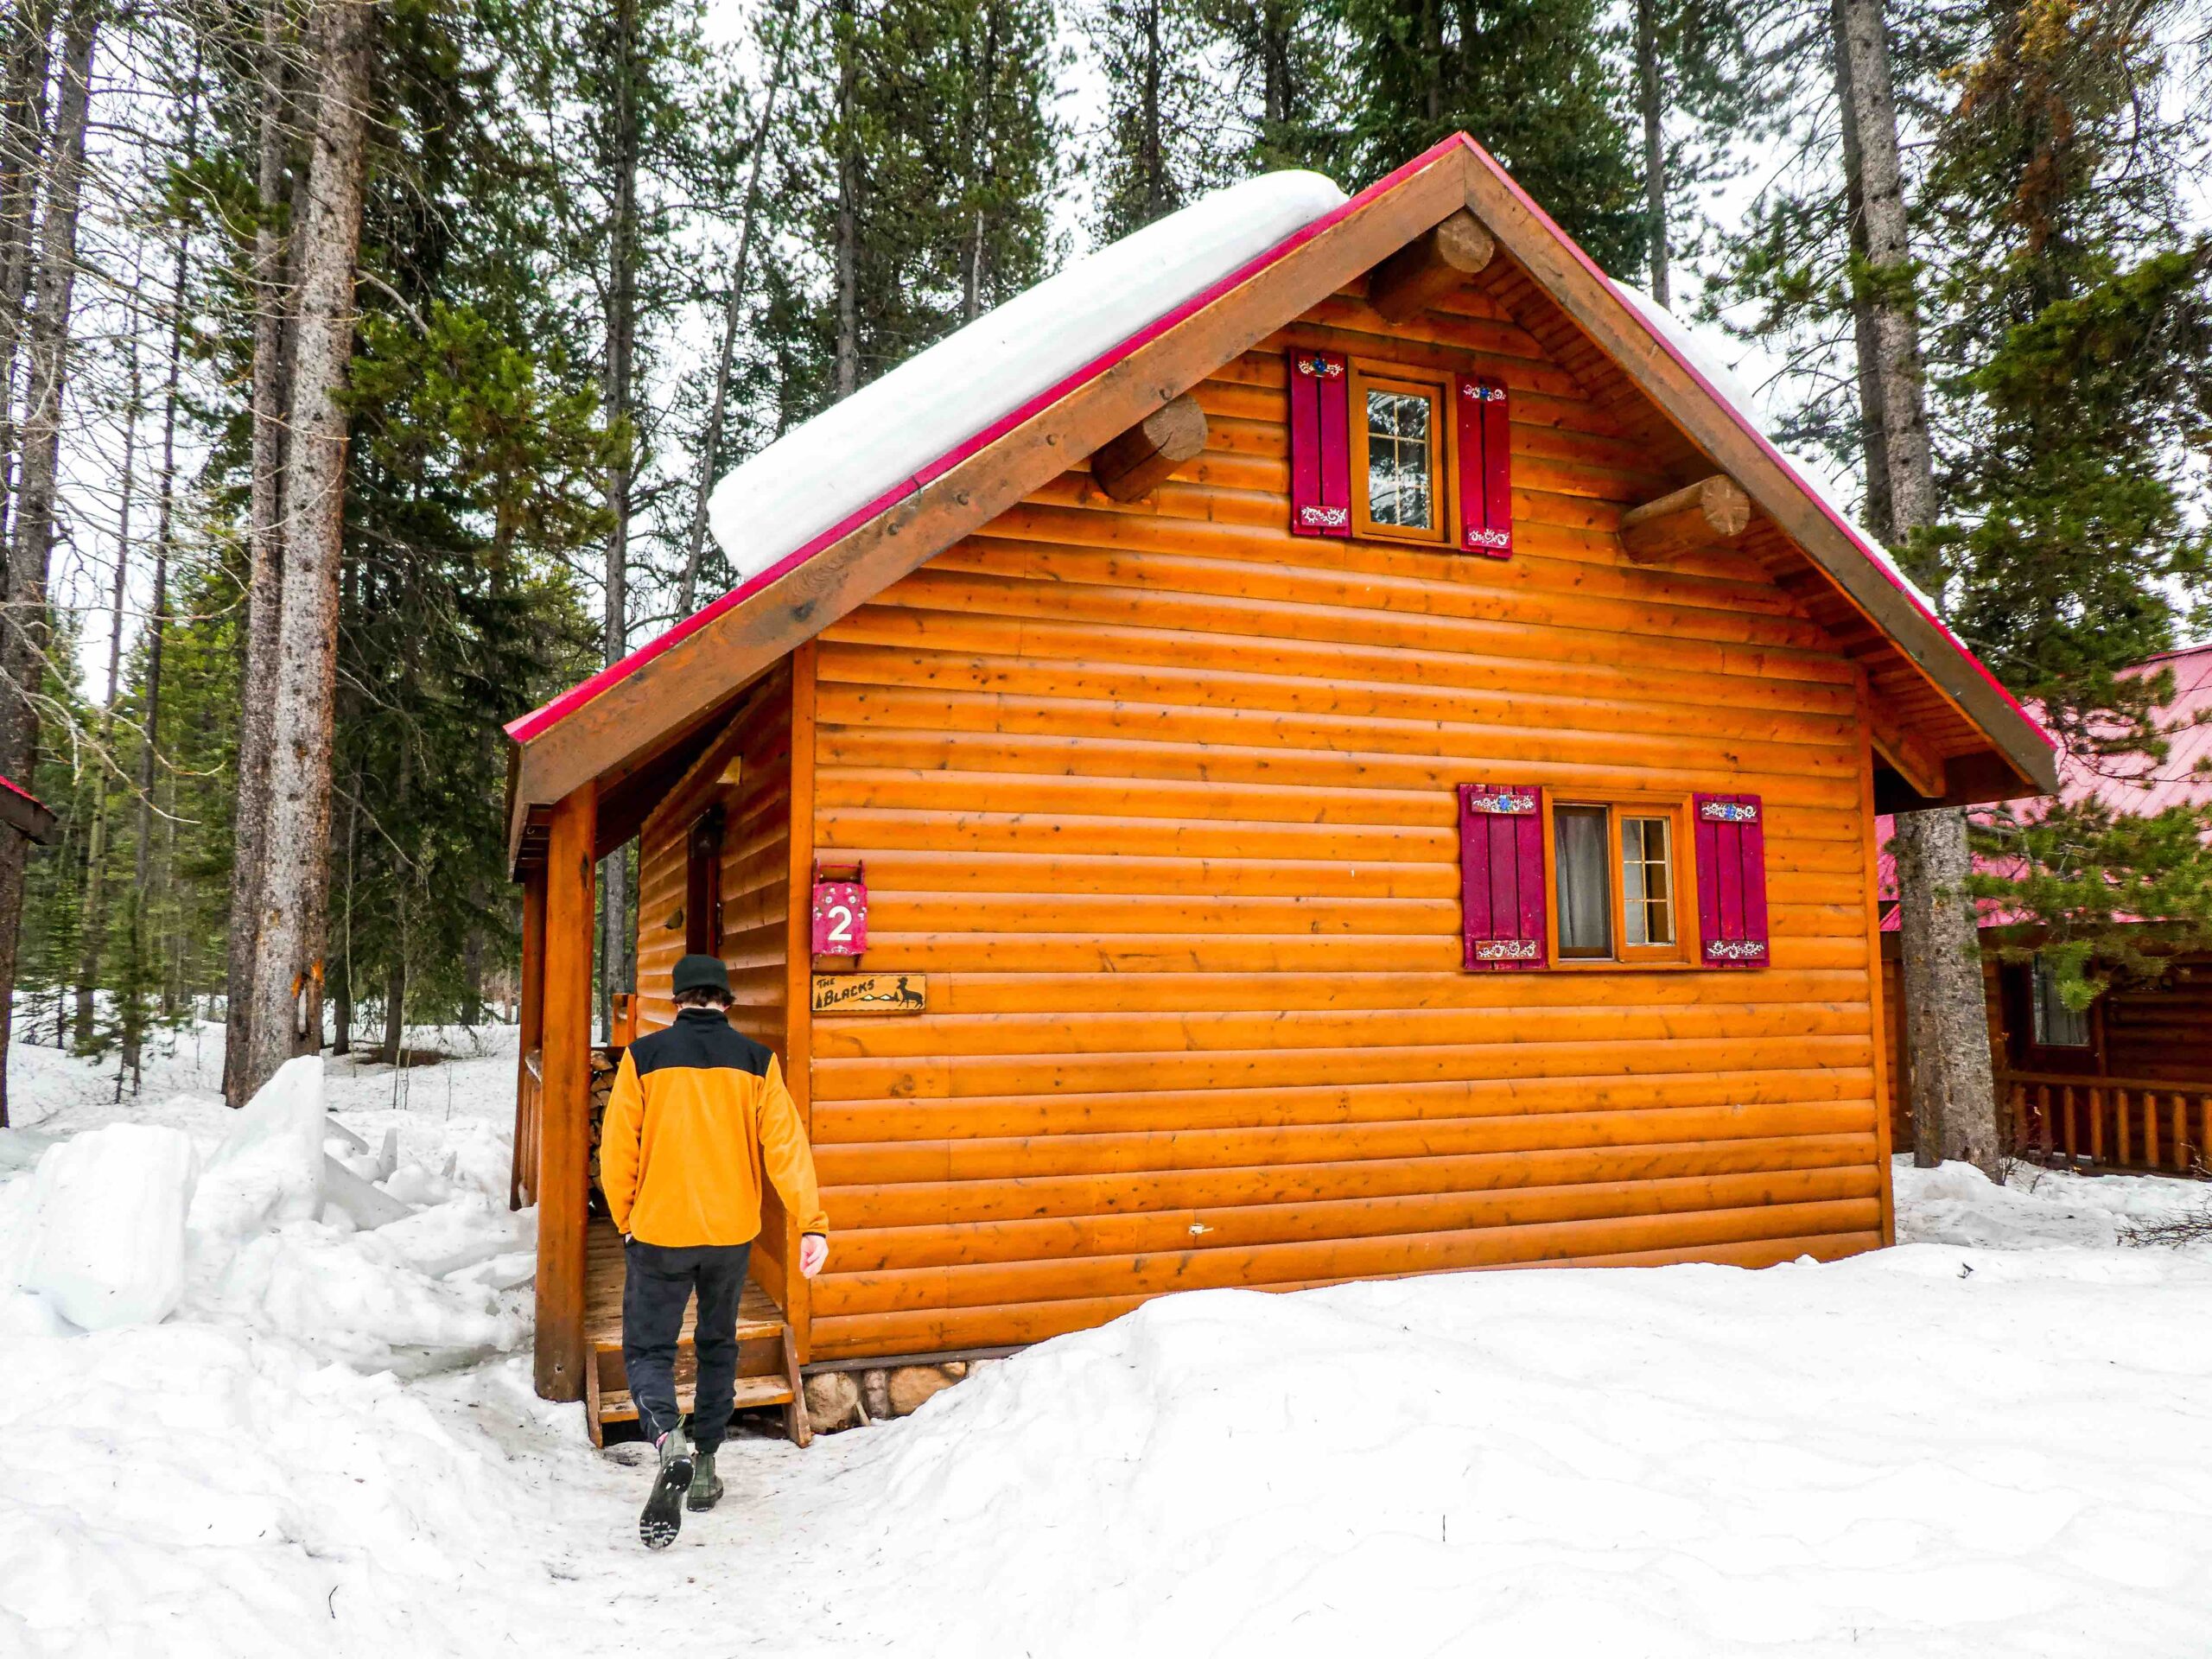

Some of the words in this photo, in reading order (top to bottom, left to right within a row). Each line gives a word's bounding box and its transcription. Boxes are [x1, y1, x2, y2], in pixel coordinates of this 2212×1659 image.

[828, 906, 852, 941] 2
[817, 978, 836, 988] THE
[823, 979, 874, 1007] BLACKS
